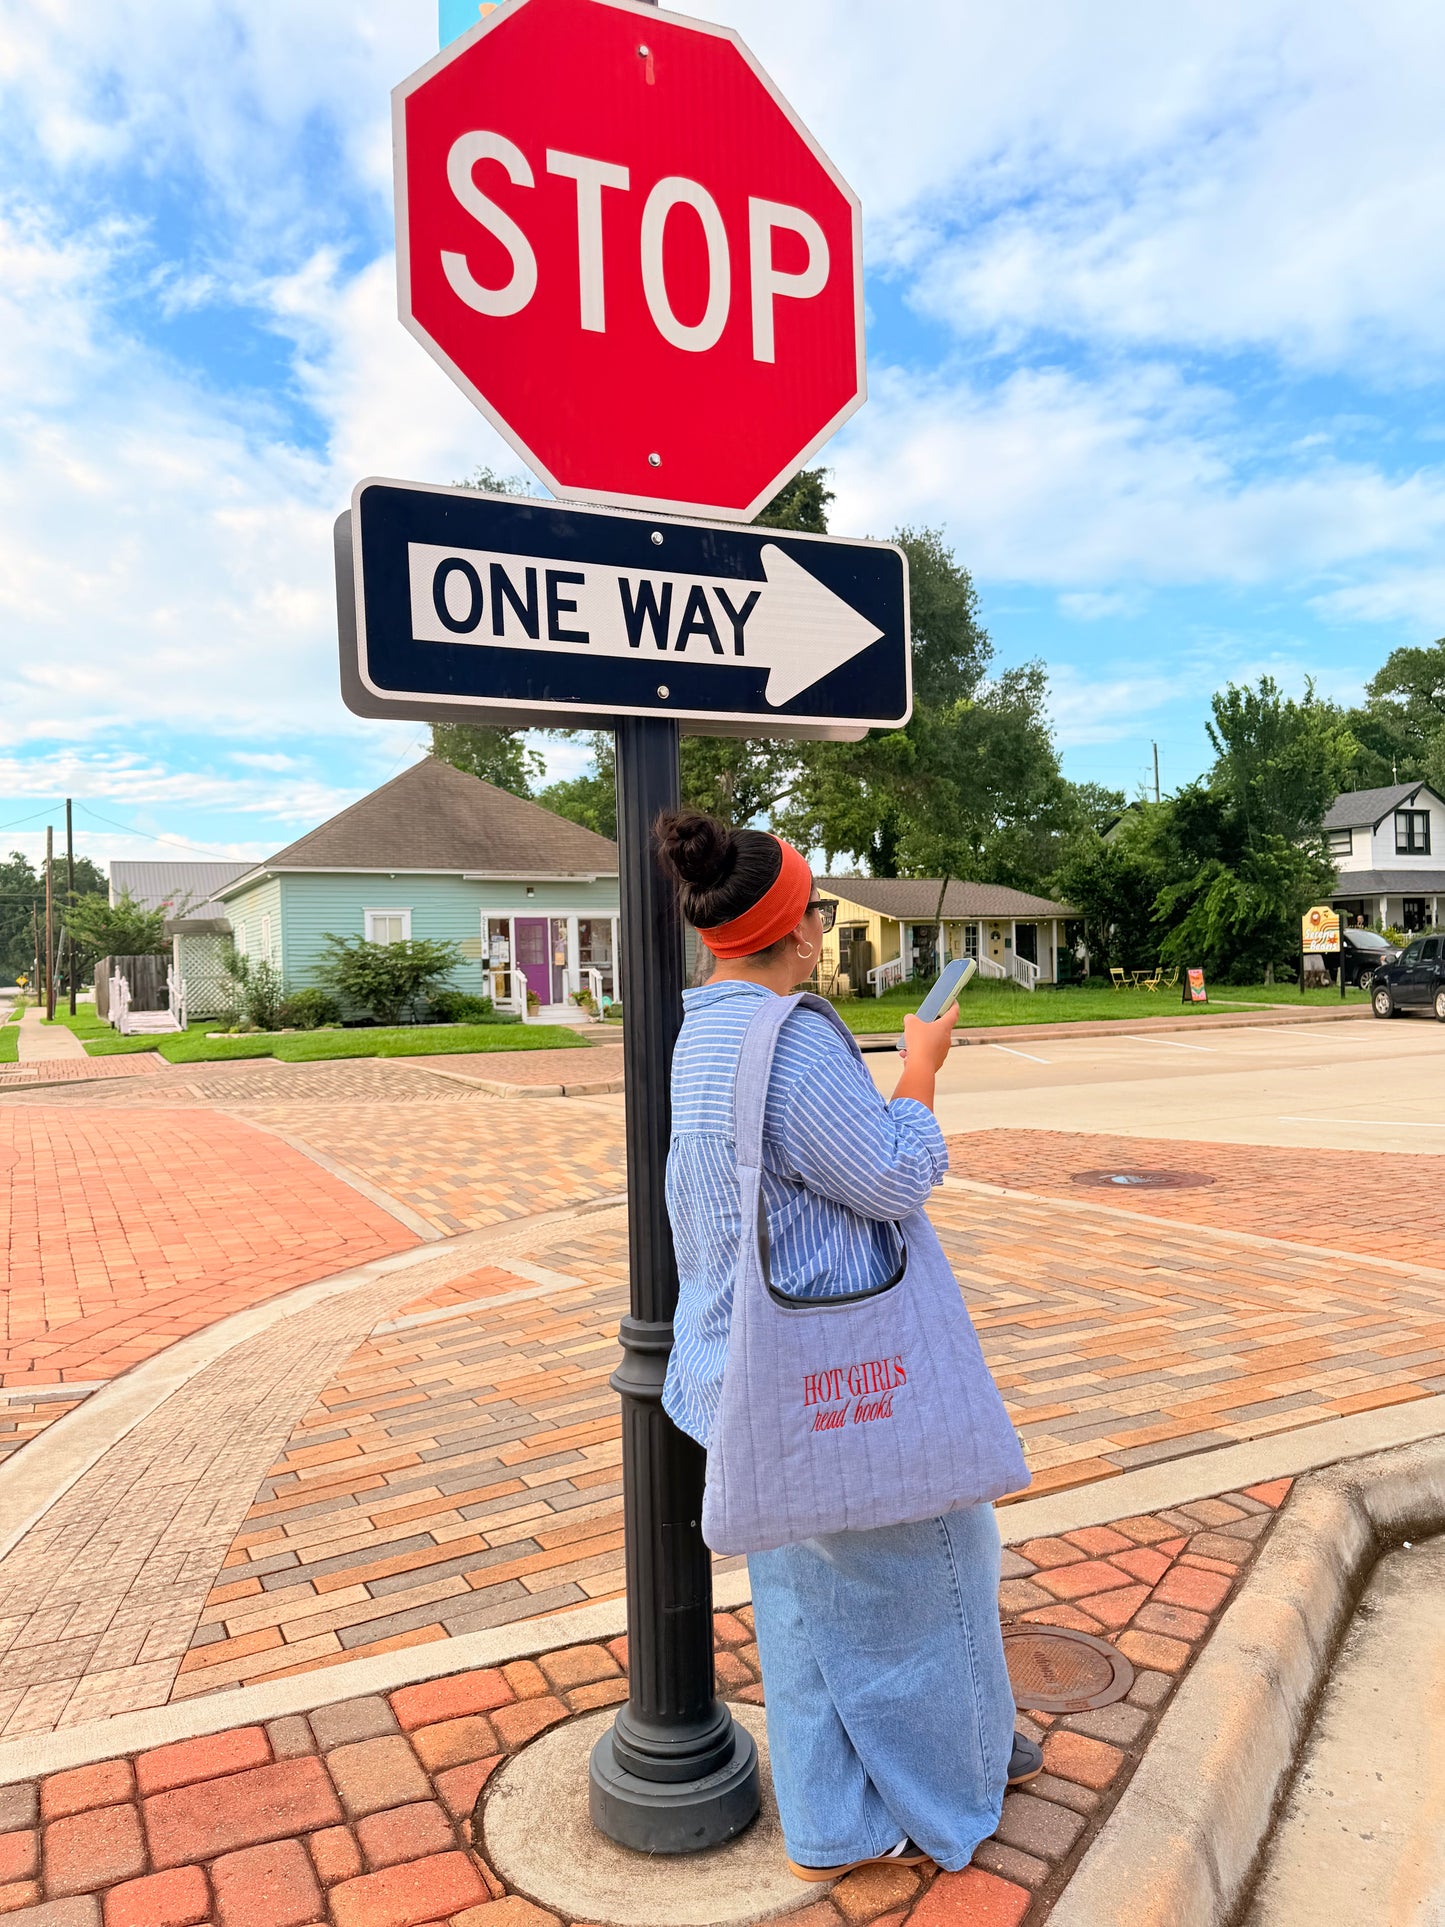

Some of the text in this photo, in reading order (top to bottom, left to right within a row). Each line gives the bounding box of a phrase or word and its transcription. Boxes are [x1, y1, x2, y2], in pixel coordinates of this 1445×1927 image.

[441, 131, 830, 364] STOP
[433, 558, 762, 657] ONE WAY
[803, 1355, 907, 1407] HOT GIRLS
[811, 1391, 894, 1433] read books
